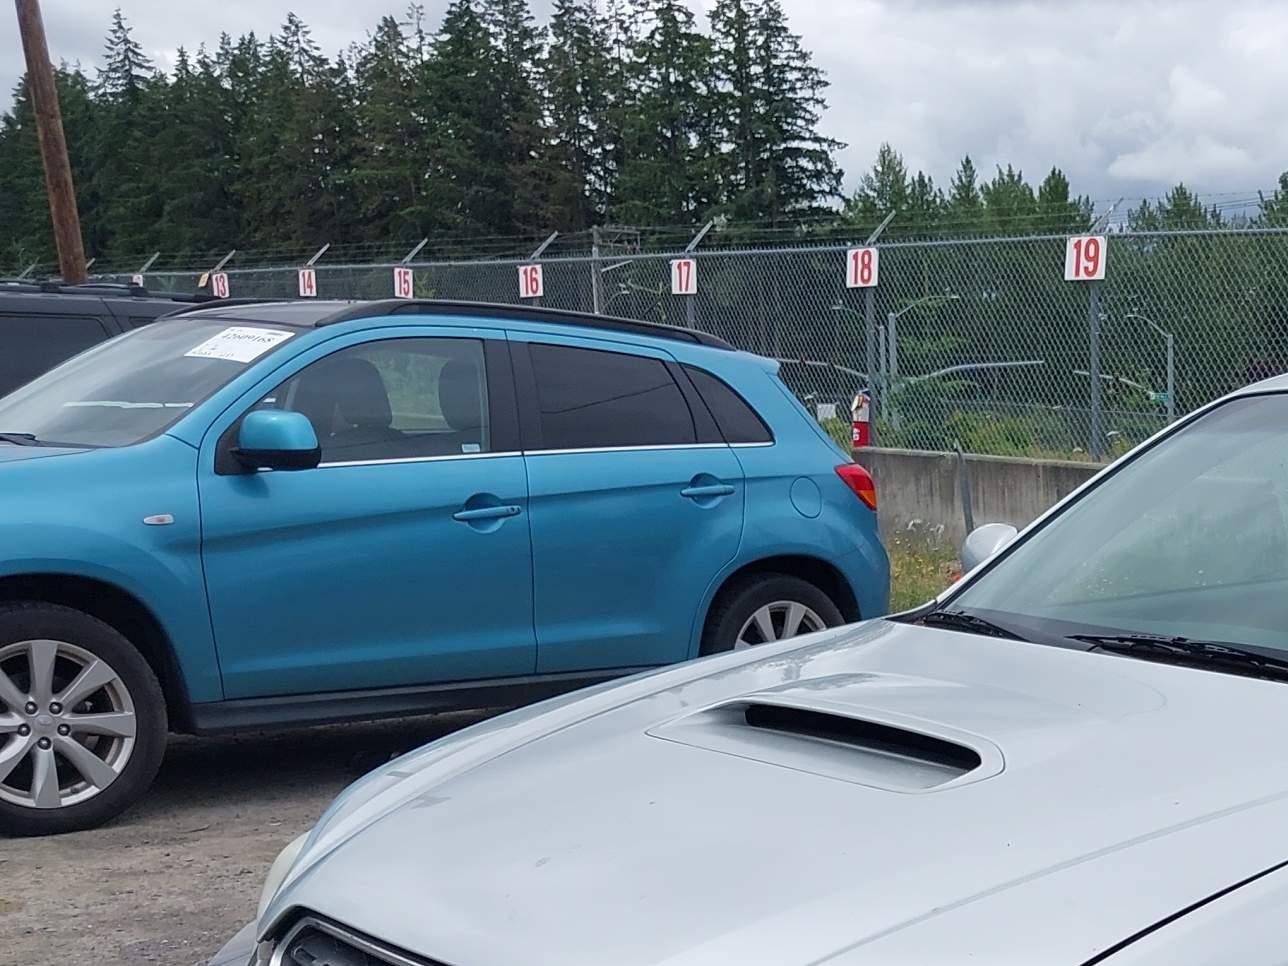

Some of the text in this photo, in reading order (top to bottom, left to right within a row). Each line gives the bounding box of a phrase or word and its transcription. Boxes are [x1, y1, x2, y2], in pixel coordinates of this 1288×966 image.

[852, 250, 873, 285] 18
[1073, 239, 1100, 278] 19
[215, 274, 226, 296] 13
[302, 271, 314, 295] 14
[396, 269, 410, 296] 15
[523, 266, 539, 295] 16
[676, 260, 692, 289] 17
